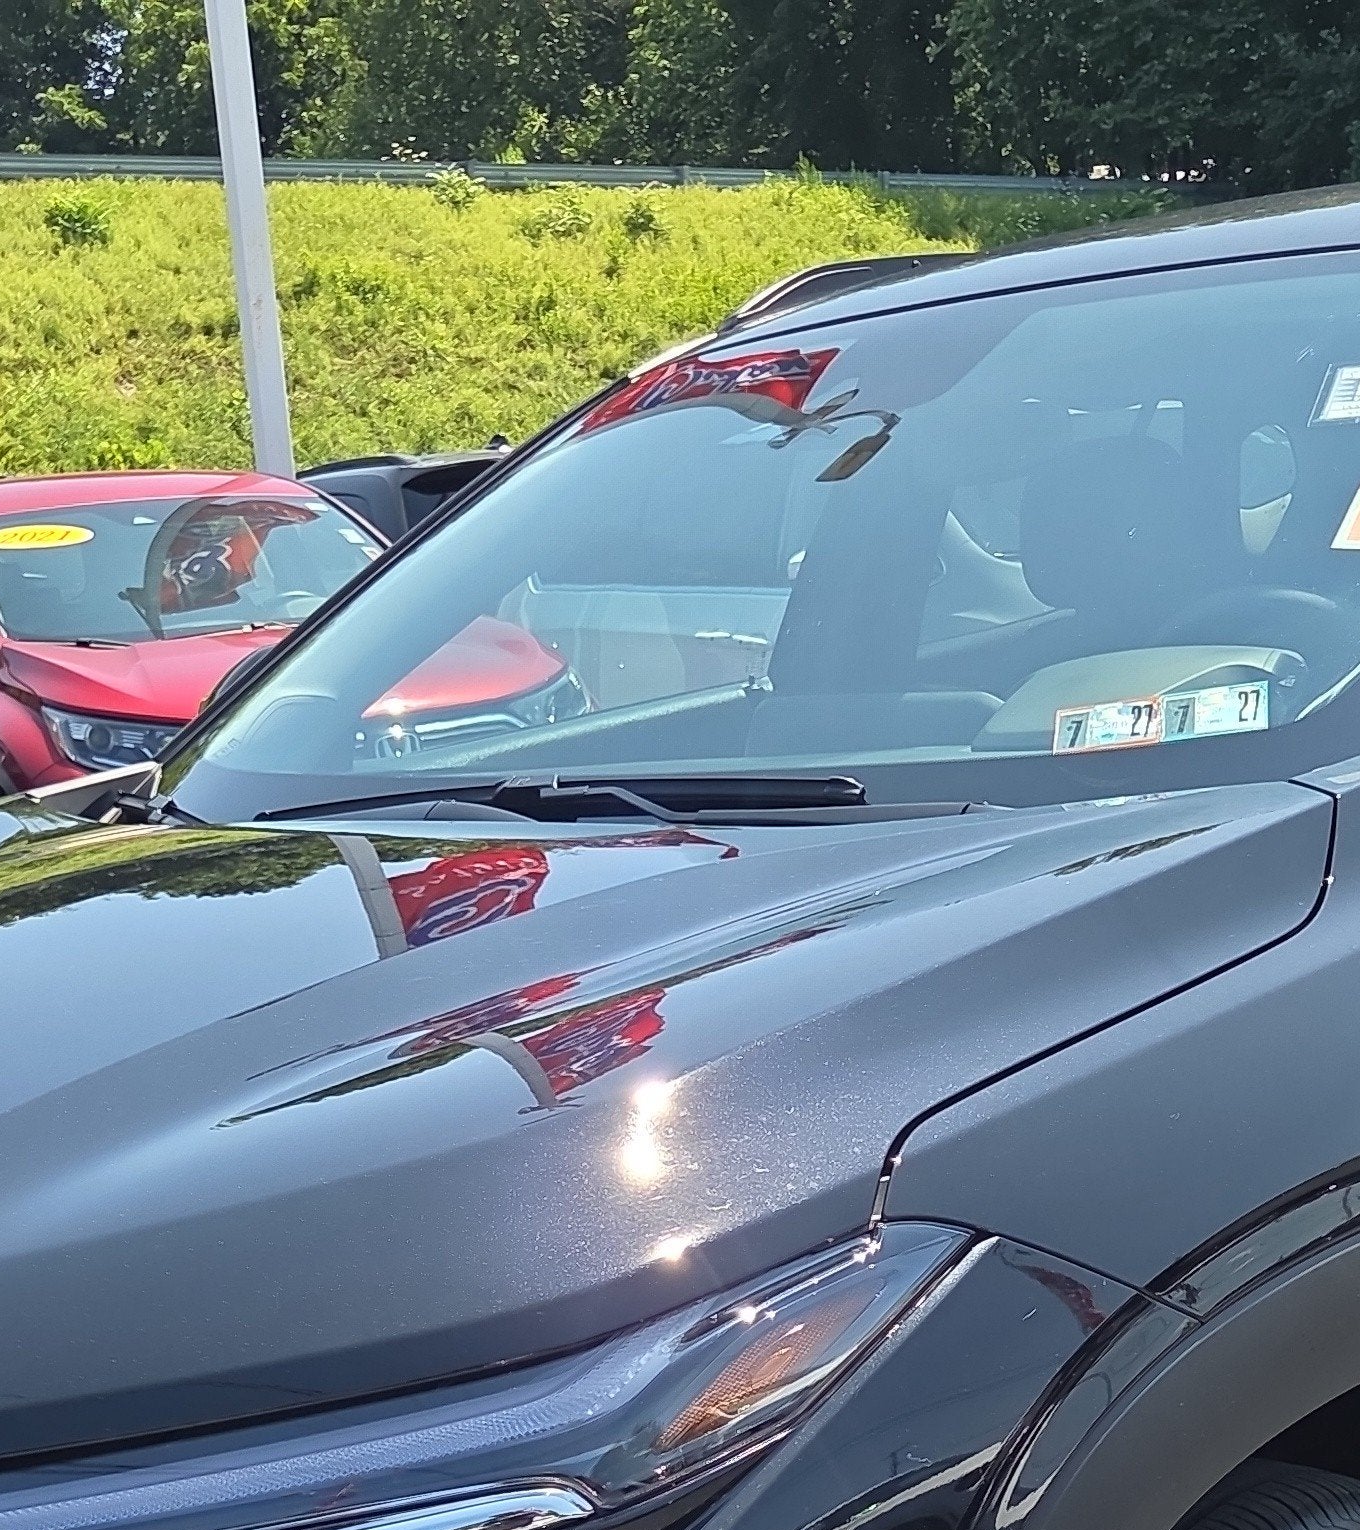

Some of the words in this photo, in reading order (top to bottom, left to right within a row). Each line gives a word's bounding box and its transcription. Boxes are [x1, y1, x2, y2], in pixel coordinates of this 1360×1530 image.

[0, 530, 71, 545] 2021
[1067, 719, 1083, 748] 7
[1130, 704, 1154, 737] 27
[1174, 704, 1190, 734] 7
[1238, 689, 1260, 722] 27
